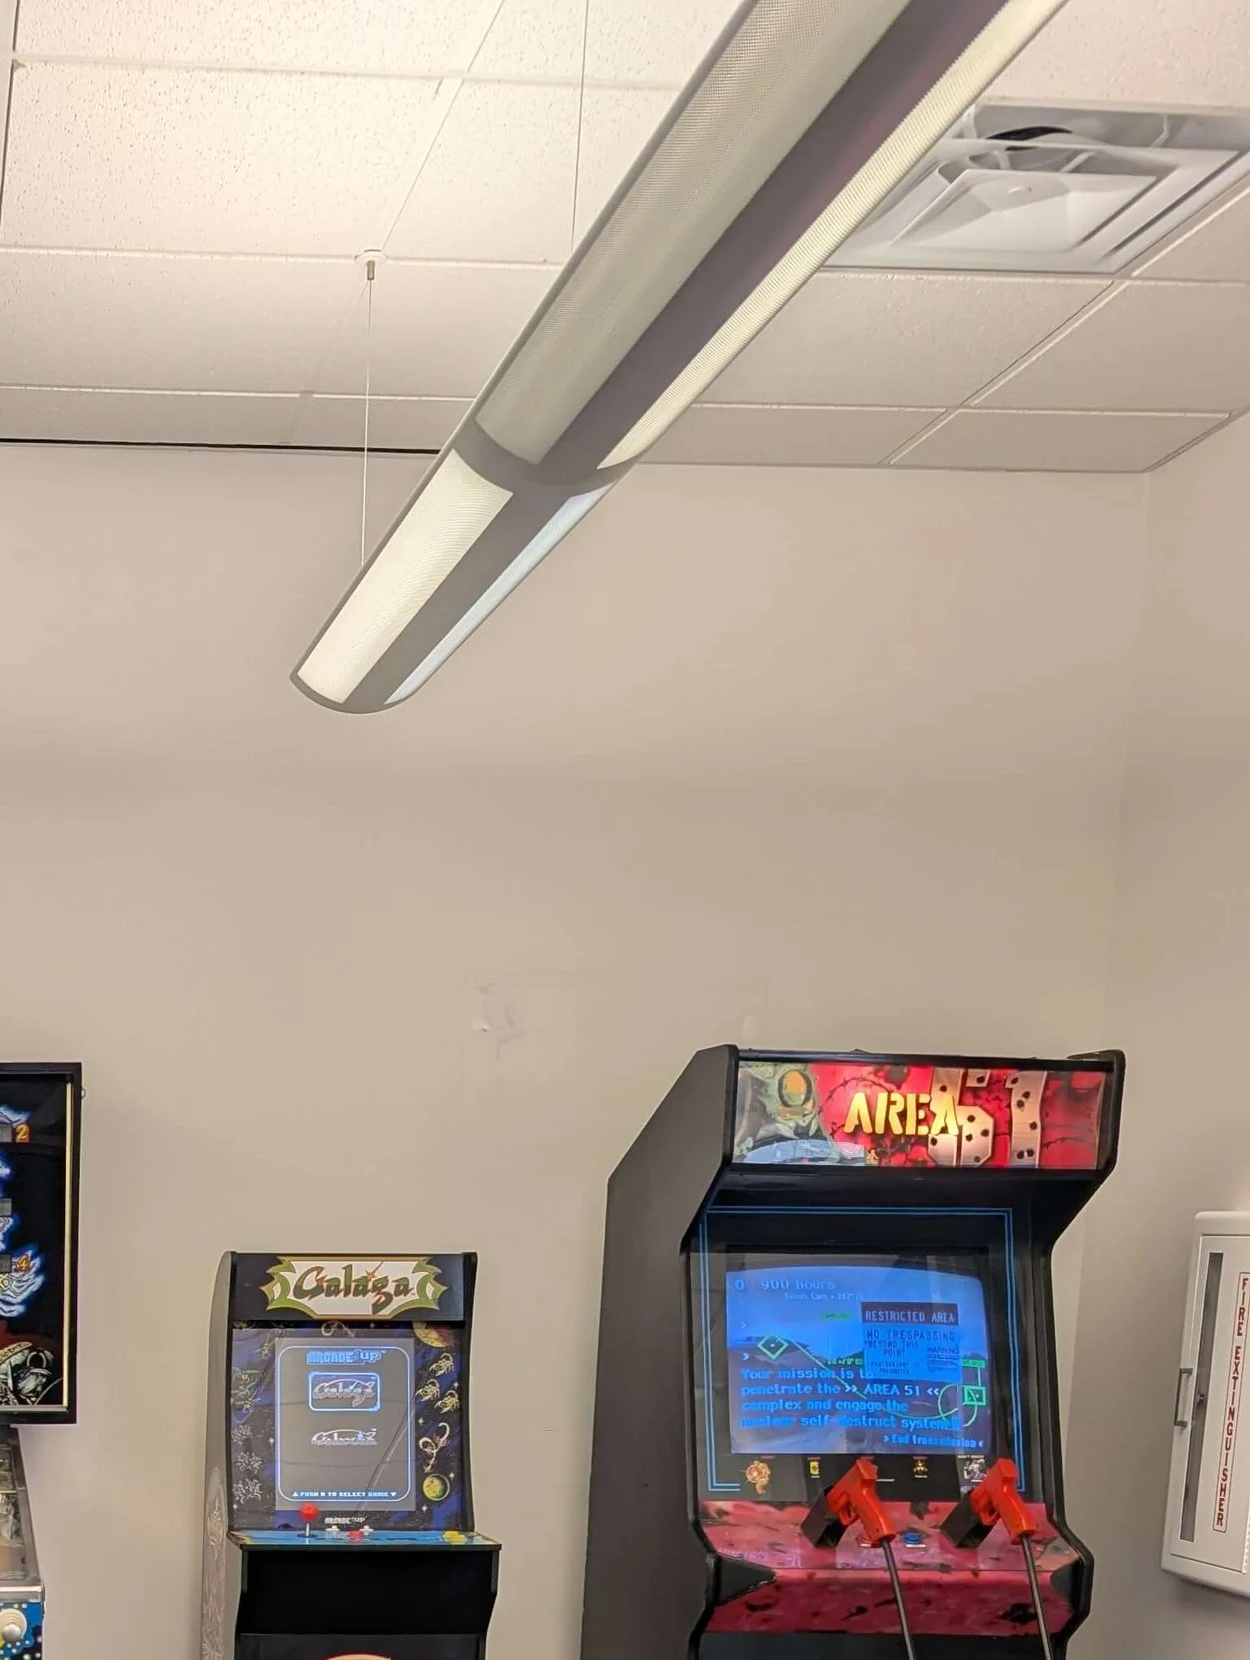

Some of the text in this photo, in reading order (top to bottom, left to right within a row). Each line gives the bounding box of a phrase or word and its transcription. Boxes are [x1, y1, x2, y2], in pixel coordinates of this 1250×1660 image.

[843, 1091, 961, 1136] AREA
[15, 1124, 29, 1142] 2
[292, 1261, 415, 1316] Galaga
[865, 1310, 955, 1323] RESTRICTED AREA
[866, 1328, 955, 1341] NO TRESPASSING
[741, 1367, 774, 1380] Your
[778, 1367, 835, 1379] mission
[840, 1367, 854, 1379] is
[741, 1383, 920, 1397] penetrate the AREA 51
[741, 1399, 909, 1412] complex and engage the
[1217, 1278, 1248, 1527] FIRE EXTINGUISHER
